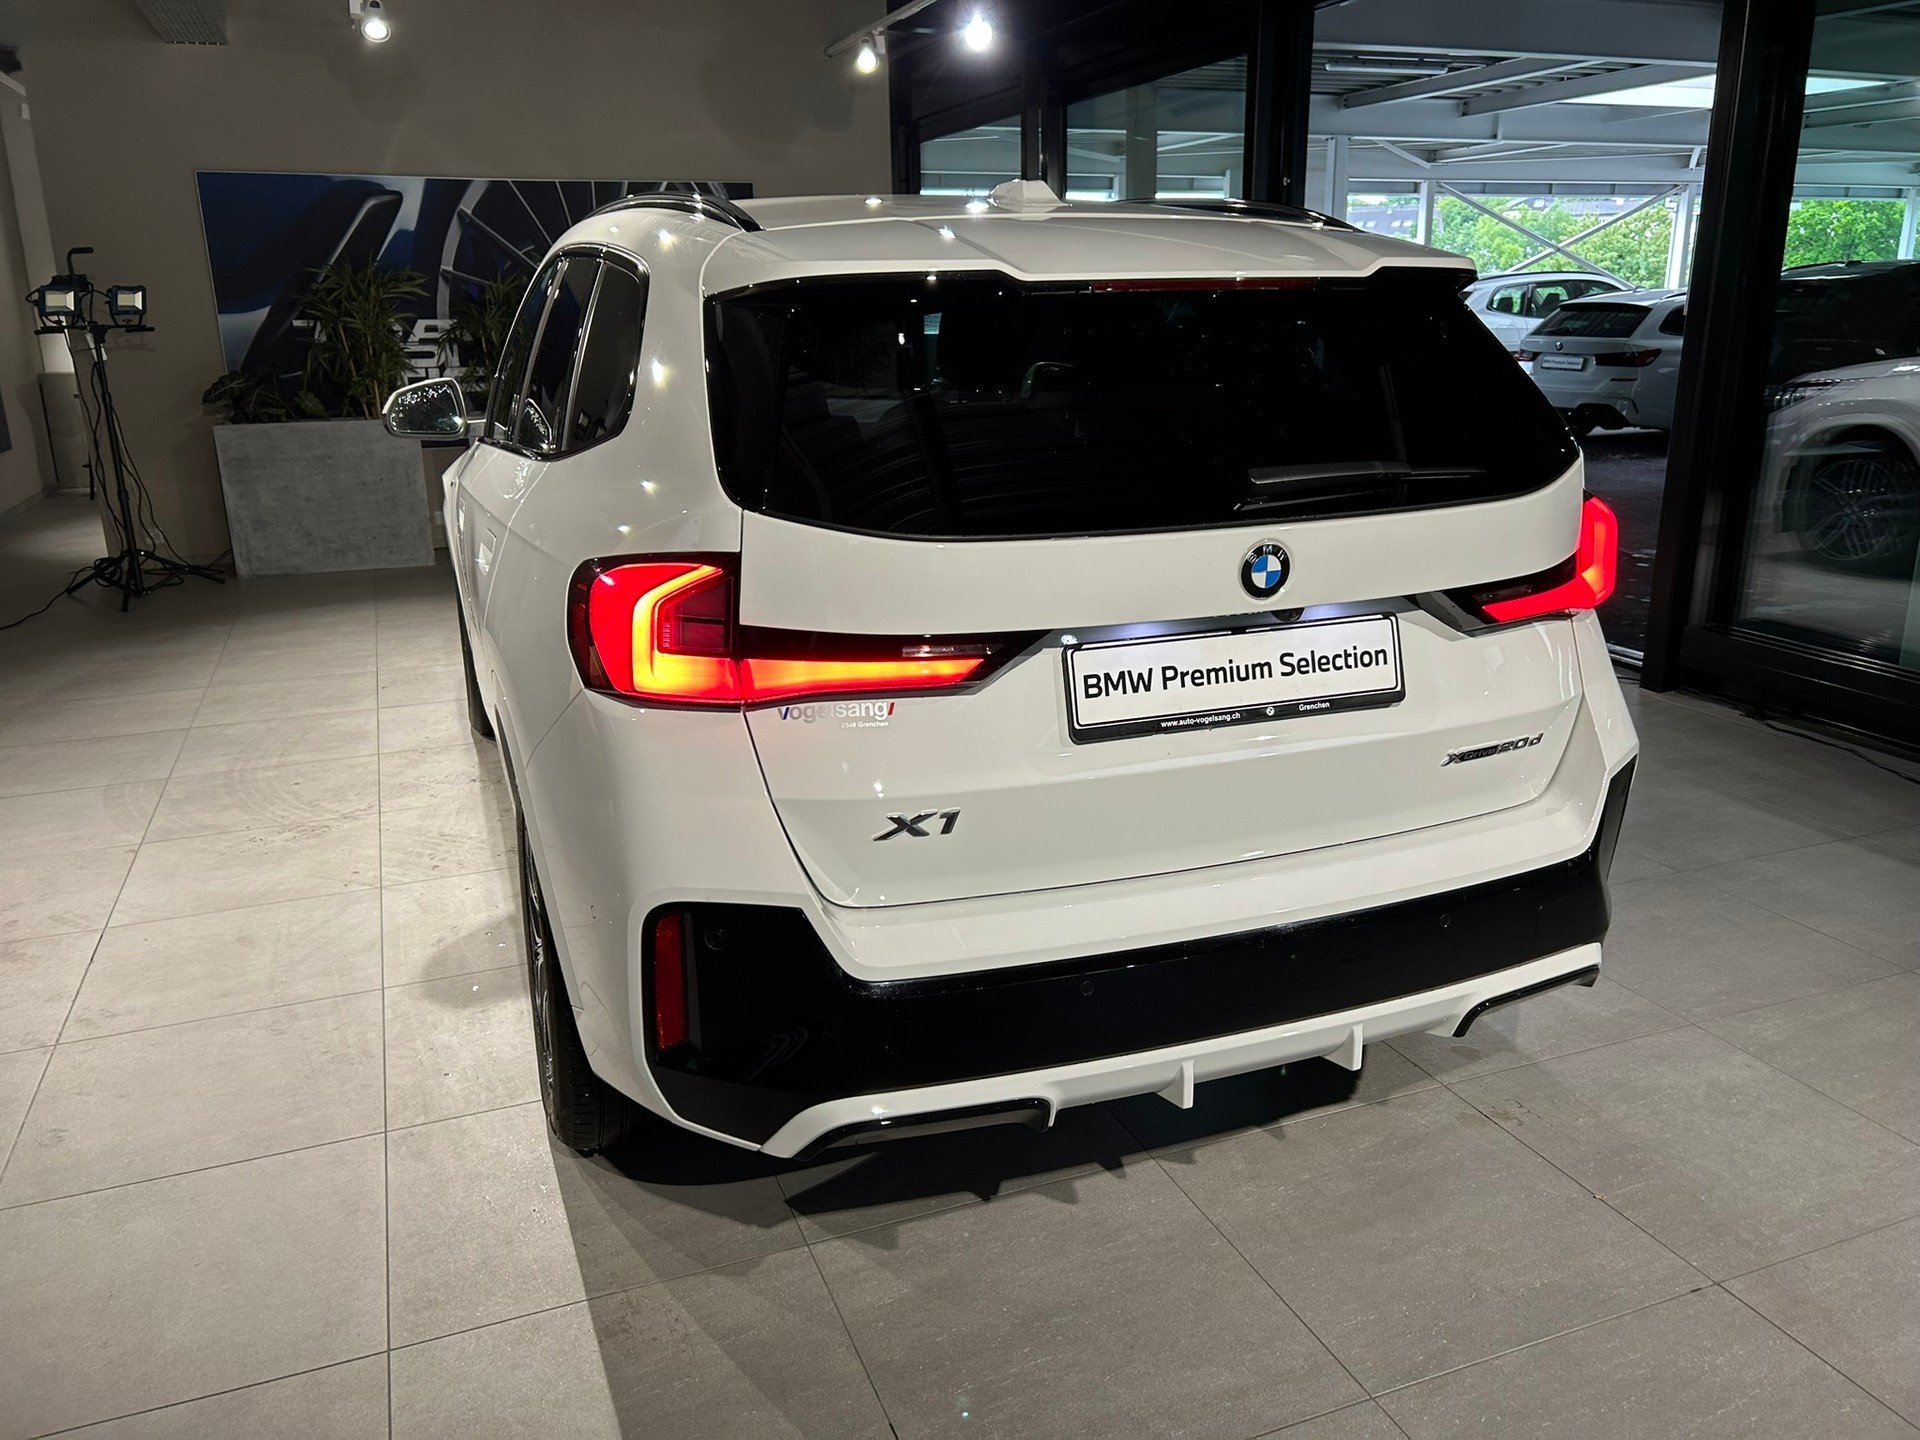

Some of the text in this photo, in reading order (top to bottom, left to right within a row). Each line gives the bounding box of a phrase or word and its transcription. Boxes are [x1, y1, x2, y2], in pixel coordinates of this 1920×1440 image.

[1083, 646, 1388, 699] BMW Premium Selection
[1160, 701, 1331, 728] www.auto-vogelsang.ch Grenchen
[872, 808, 961, 841] X1
